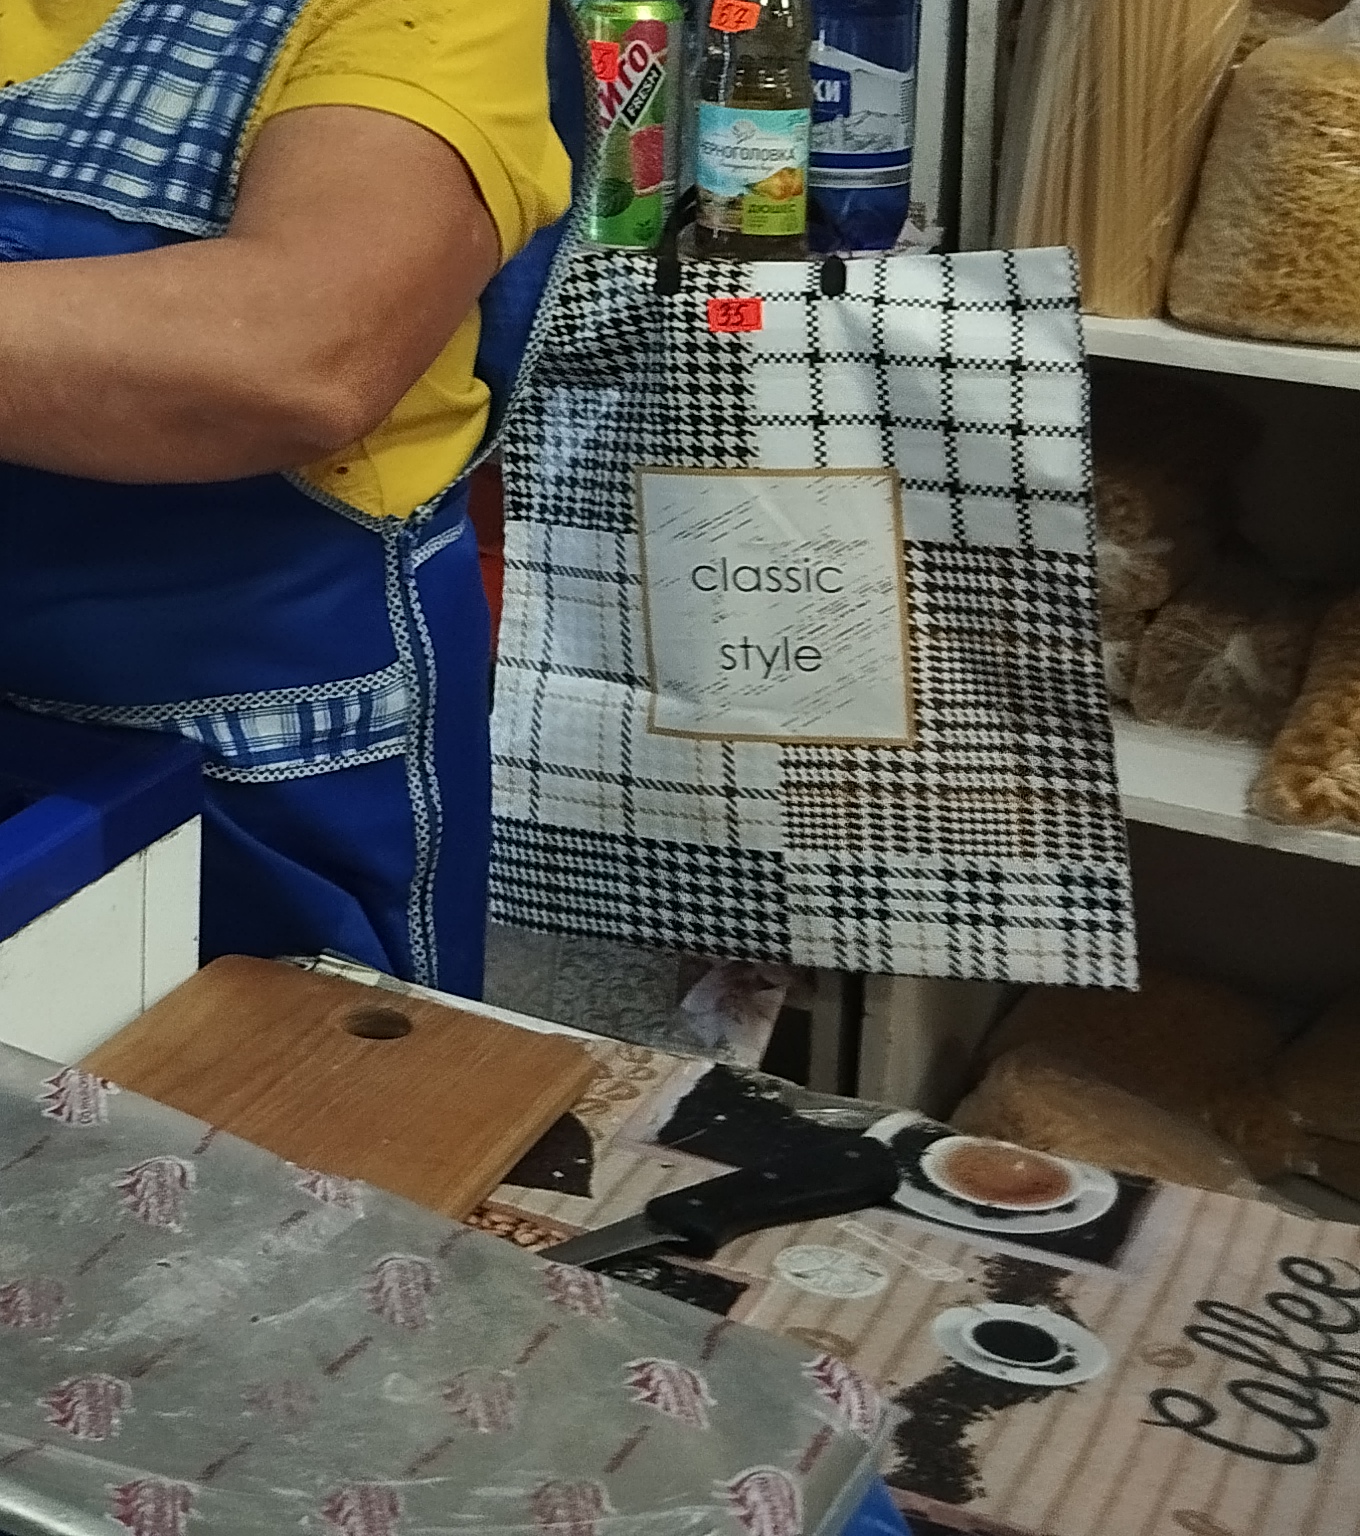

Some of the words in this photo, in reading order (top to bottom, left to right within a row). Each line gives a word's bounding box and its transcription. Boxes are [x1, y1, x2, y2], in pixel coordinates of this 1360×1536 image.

[623, 65, 664, 120] FRESH
[690, 556, 845, 595] classic
[719, 636, 823, 680] style
